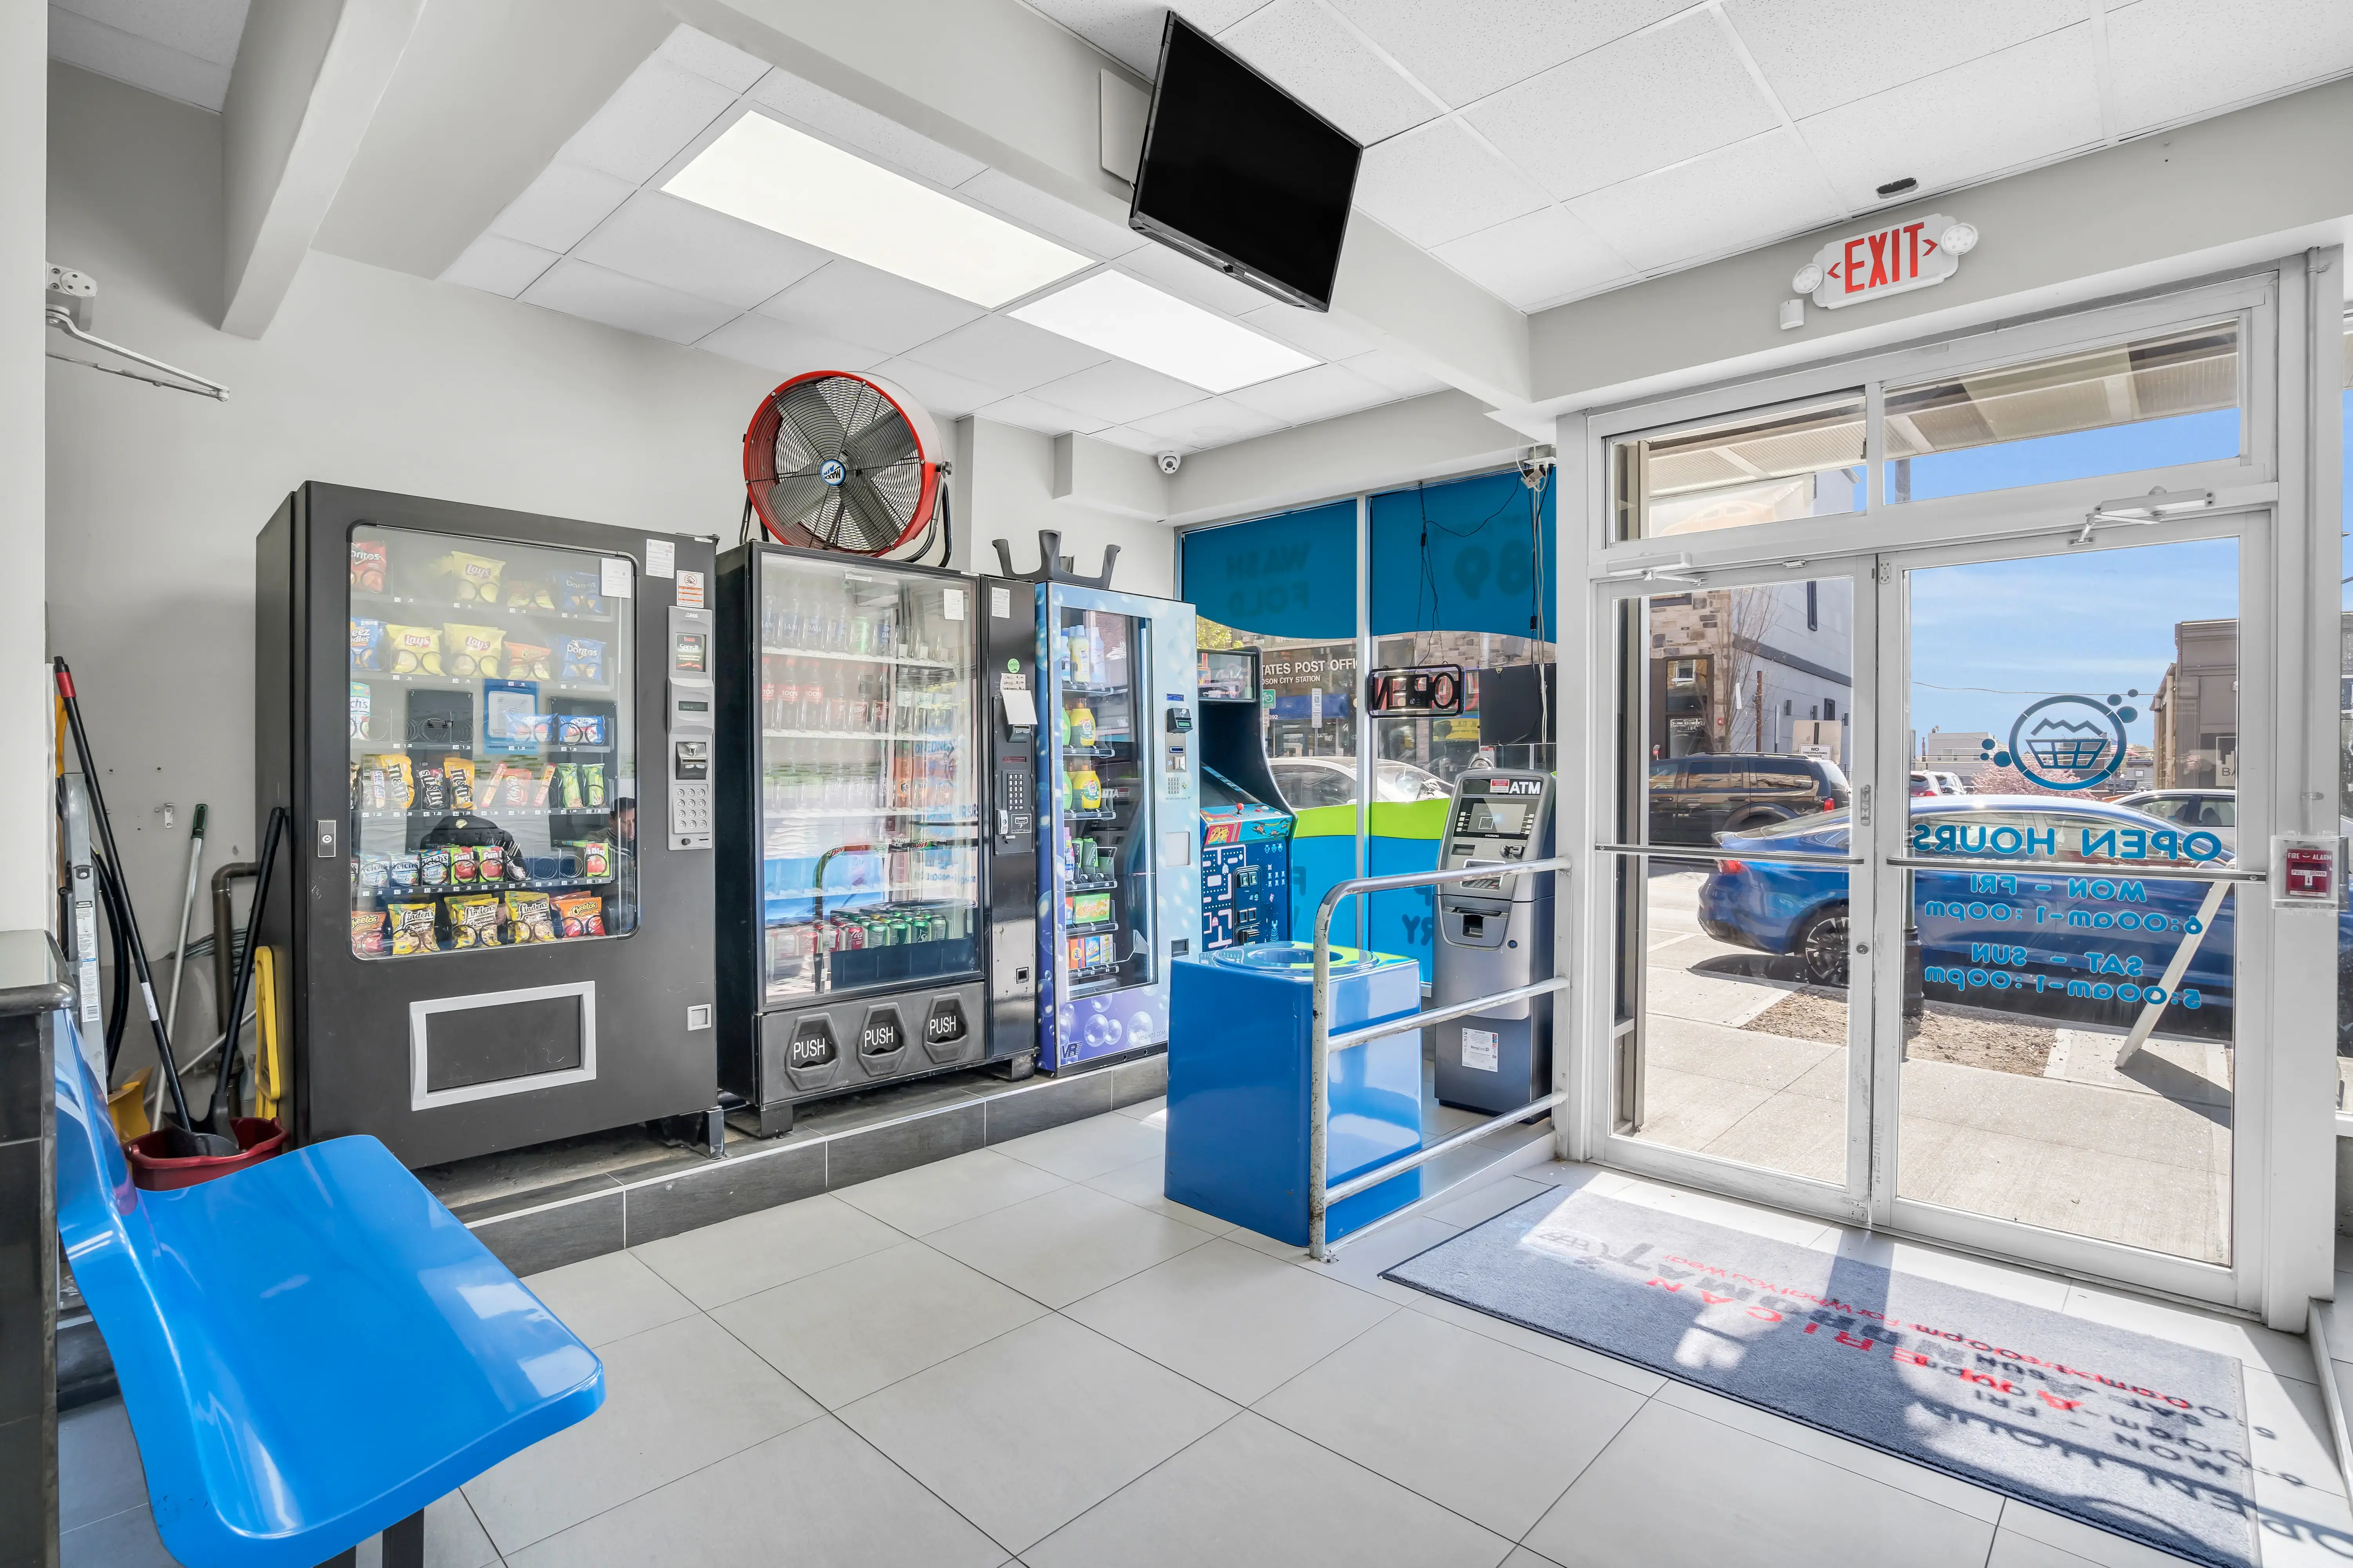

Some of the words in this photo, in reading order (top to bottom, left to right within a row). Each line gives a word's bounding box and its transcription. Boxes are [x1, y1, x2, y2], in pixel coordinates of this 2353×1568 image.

[1845, 222, 1924, 294] EXIT
[351, 550, 380, 560] oritos
[567, 644, 598, 657] Doritos
[1295, 660, 1325, 674] POST
[1330, 658, 1356, 671] OFFI
[1280, 676, 1293, 684] CITY
[1295, 675, 1320, 683] STATION
[374, 771, 385, 798] SNICKERS
[1509, 781, 1540, 794] ATM
[592, 847, 606, 856] Dip
[571, 902, 597, 916] Cheetos
[1085, 904, 1097, 913] Gain
[469, 916, 494, 925] Chocolate
[929, 1016, 956, 1036] PUSH
[864, 1026, 893, 1047] PUSH
[1138, 1030, 1166, 1041] VENDRITE.COM
[794, 1038, 825, 1060] PUSH
[1663, 1254, 1727, 1279] Wear
[1730, 1272, 1777, 1294] You
[1779, 1286, 1852, 1315] What
[1856, 1307, 1900, 1329] For
[1646, 1276, 2085, 1412] AMERICAN
